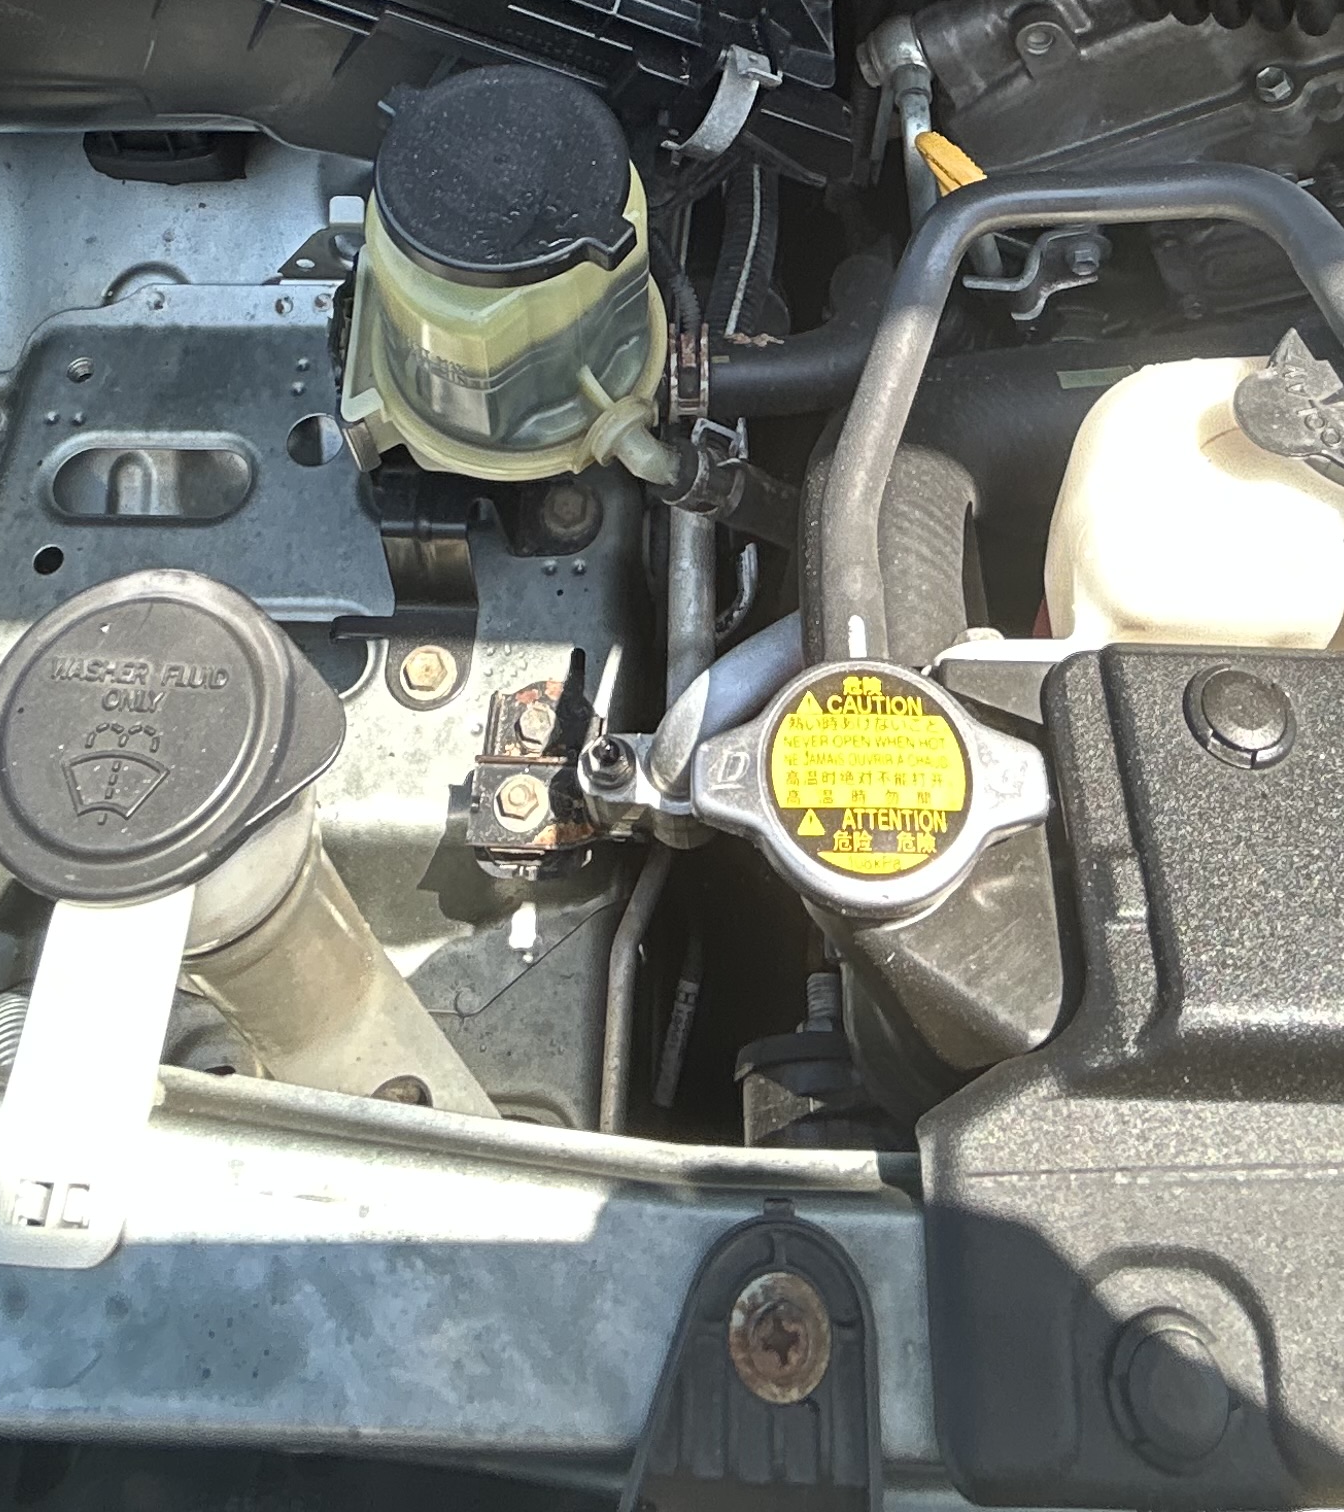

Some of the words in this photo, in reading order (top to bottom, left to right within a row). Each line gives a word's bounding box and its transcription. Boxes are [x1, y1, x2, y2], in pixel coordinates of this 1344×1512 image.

[51, 658, 149, 686] WASHER
[161, 662, 230, 689] FLUID
[101, 689, 166, 713] ONLY
[827, 696, 923, 717] CAUTION
[784, 735, 829, 749] NEVER
[833, 735, 870, 749] OPEN
[875, 735, 915, 749] WHEN
[919, 737, 945, 750] HOT
[784, 753, 799, 766] NE
[804, 751, 845, 766] JAMAIS
[848, 753, 894, 766] OUVRIR
[842, 809, 948, 833] ATTENTION
[833, 829, 873, 853] 危险
